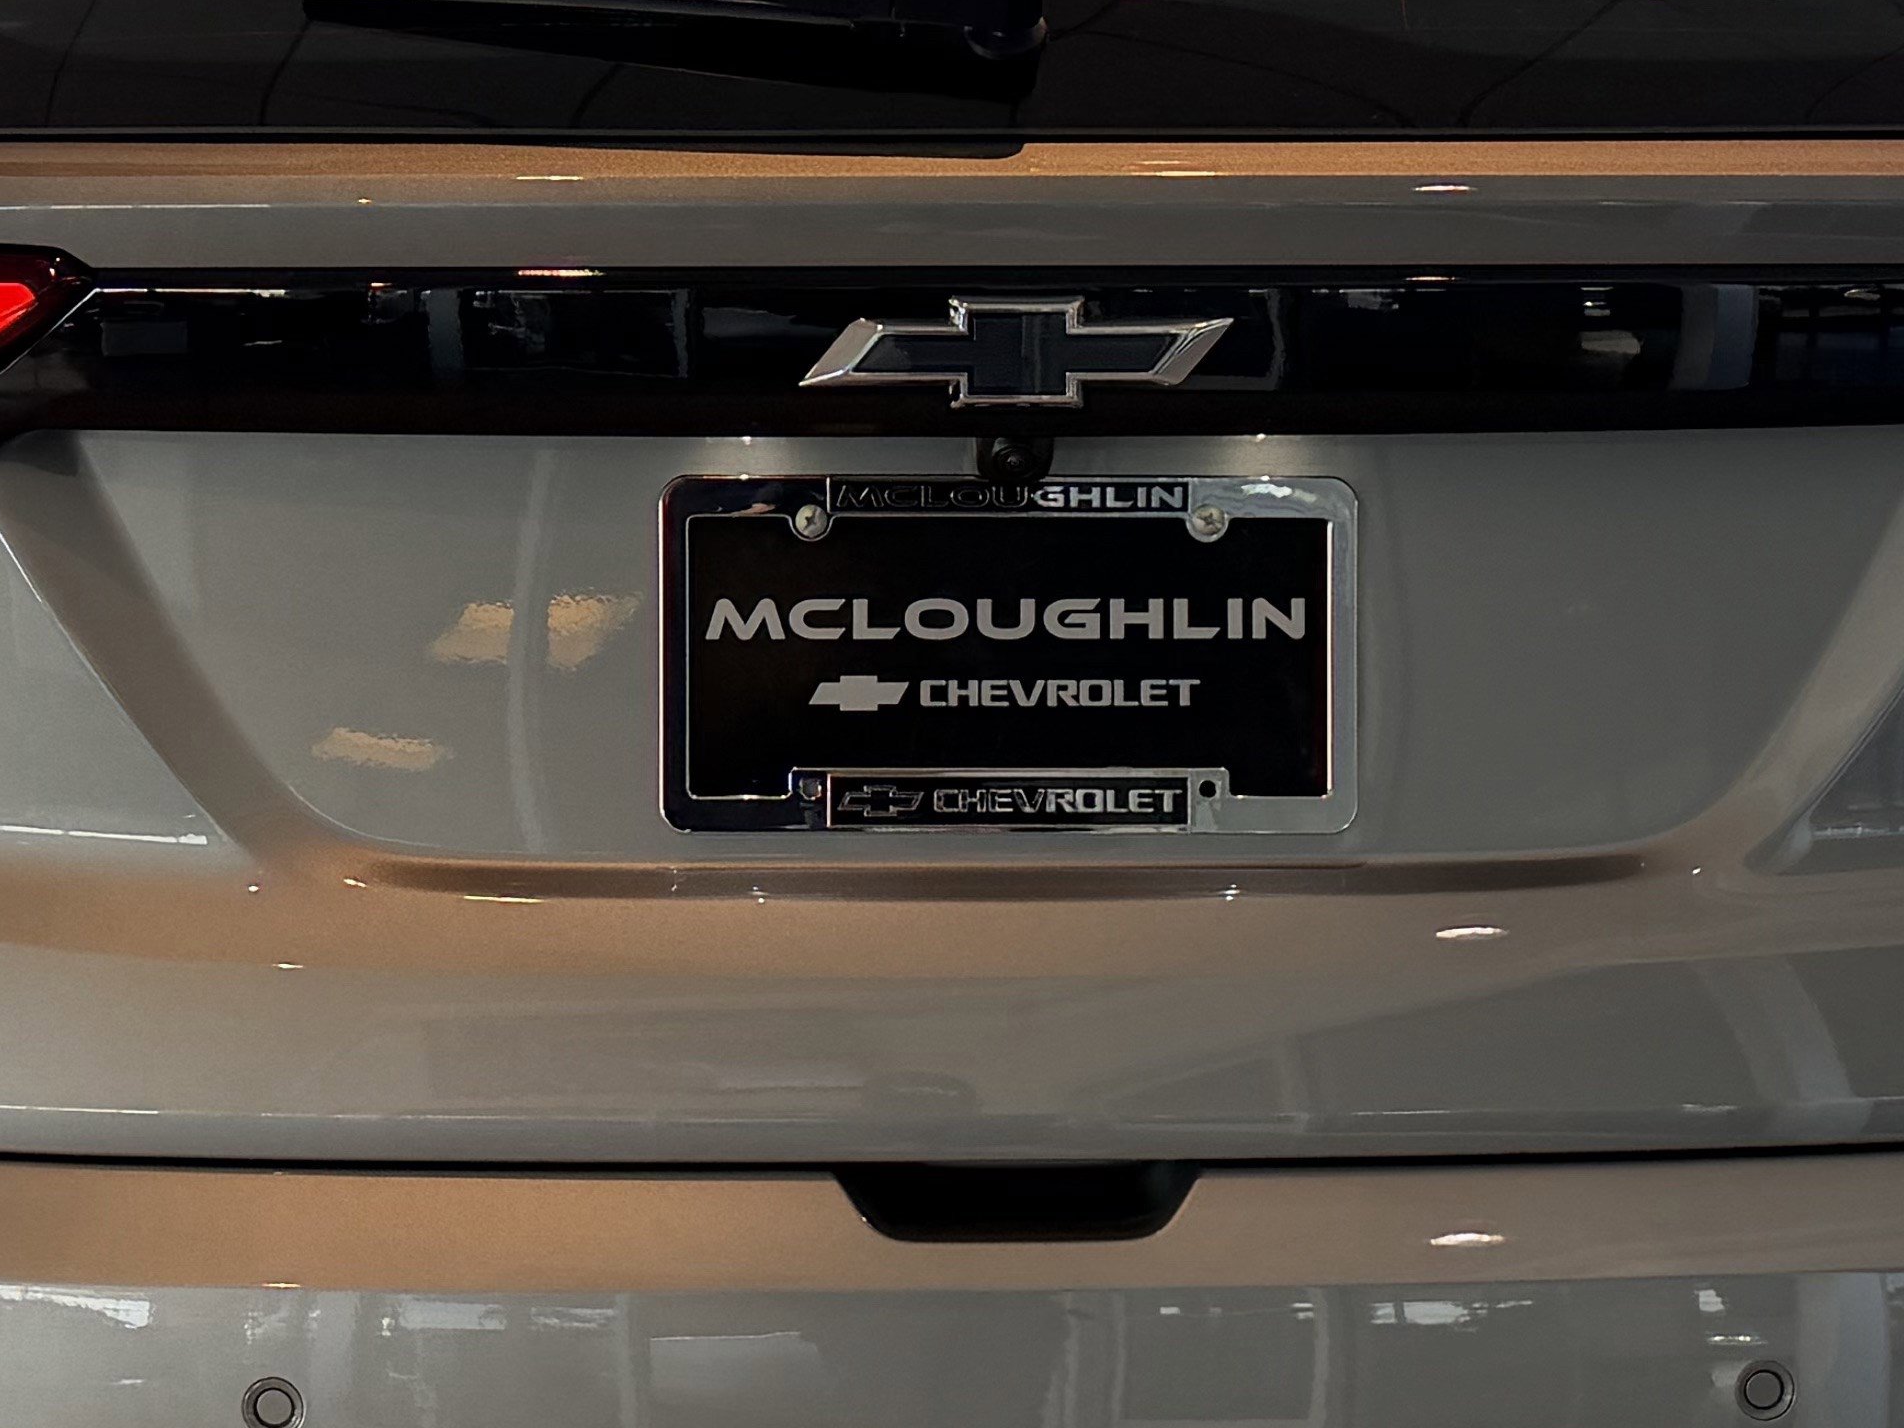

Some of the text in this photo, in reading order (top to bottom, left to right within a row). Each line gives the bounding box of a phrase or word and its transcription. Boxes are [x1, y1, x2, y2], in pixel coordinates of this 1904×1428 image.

[834, 483, 1186, 510] MCLOUGHLIN
[705, 598, 1306, 640] MCLOUGHLIN
[919, 678, 1201, 707] CHEVROLET
[933, 787, 1184, 814] CHEVROLET
